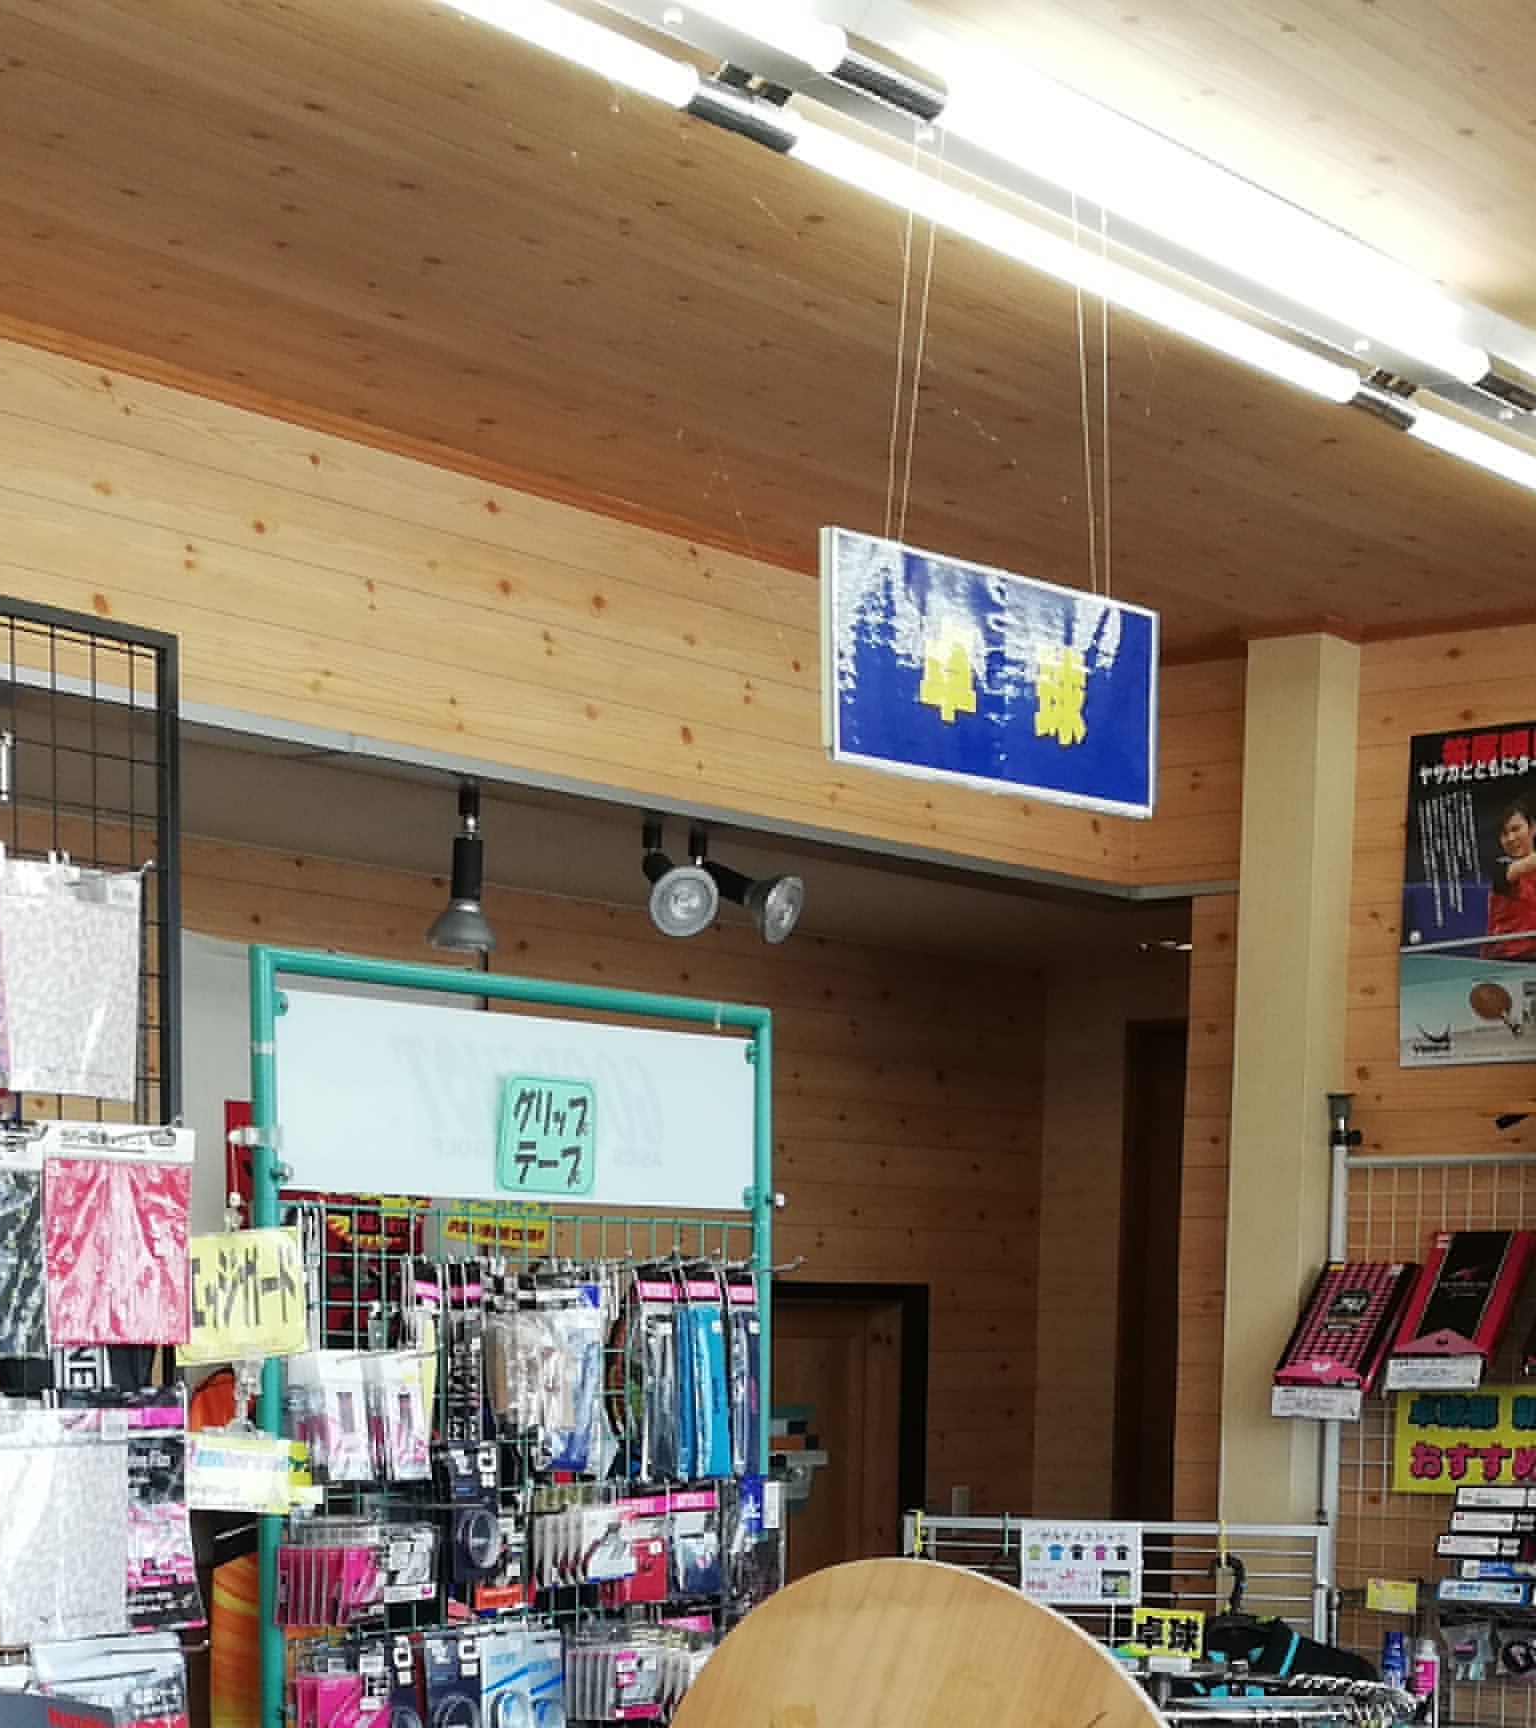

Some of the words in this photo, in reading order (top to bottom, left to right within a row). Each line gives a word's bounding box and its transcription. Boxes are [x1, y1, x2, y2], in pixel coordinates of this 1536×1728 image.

[513, 1086, 591, 1138] グリップ
[513, 1140, 586, 1187] テープ
[1136, 1617, 1200, 1650] 卓球
